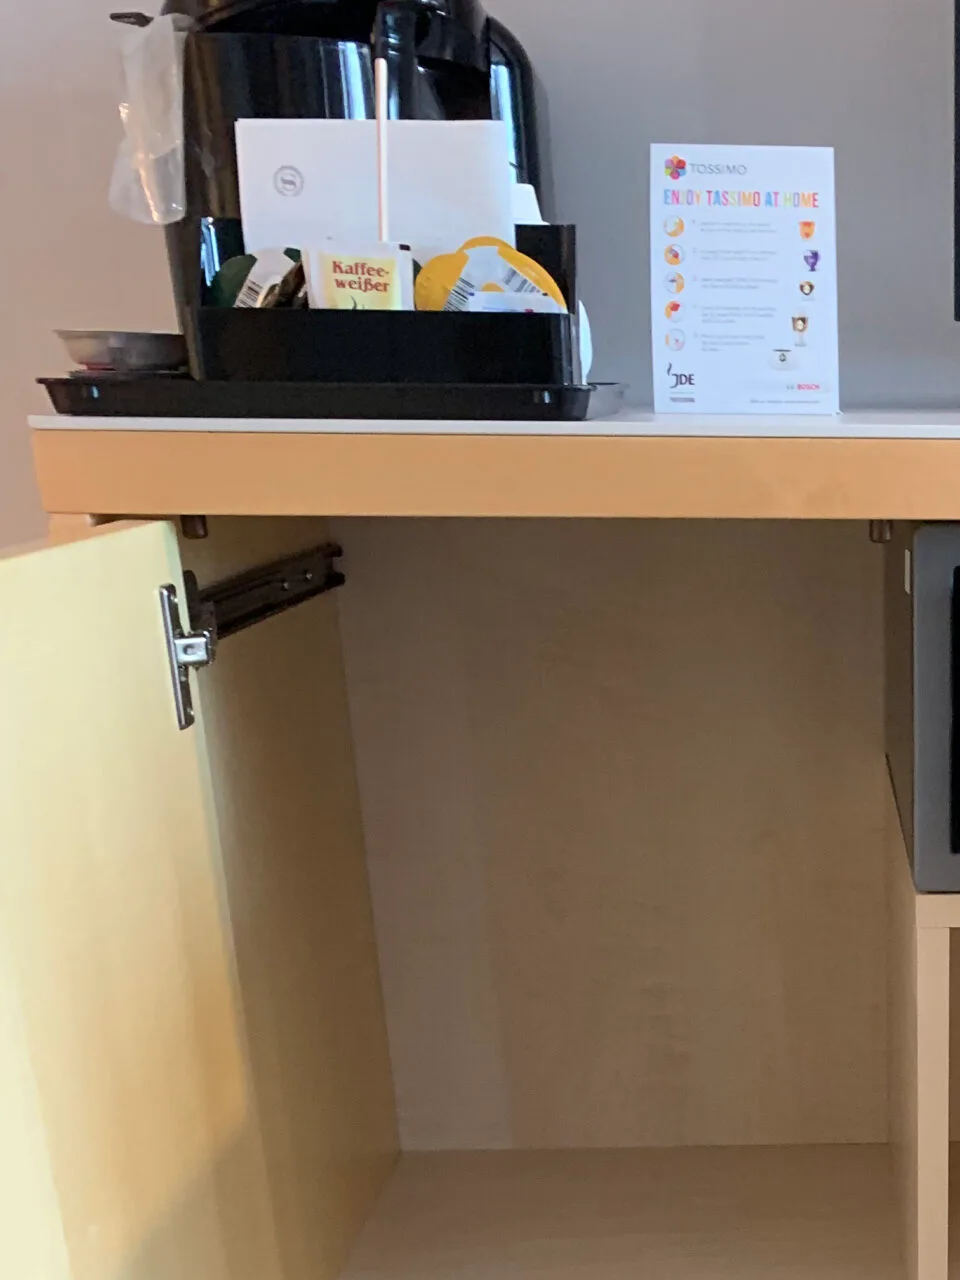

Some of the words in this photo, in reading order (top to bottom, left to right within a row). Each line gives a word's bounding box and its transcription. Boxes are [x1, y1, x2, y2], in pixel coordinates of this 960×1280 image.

[663, 188, 702, 206] ENJOY
[706, 190, 761, 207] TASSIMO
[764, 191, 780, 207] AT
[783, 191, 819, 208] HOME
[332, 261, 389, 278] Kaffee-
[334, 276, 390, 293] weißer
